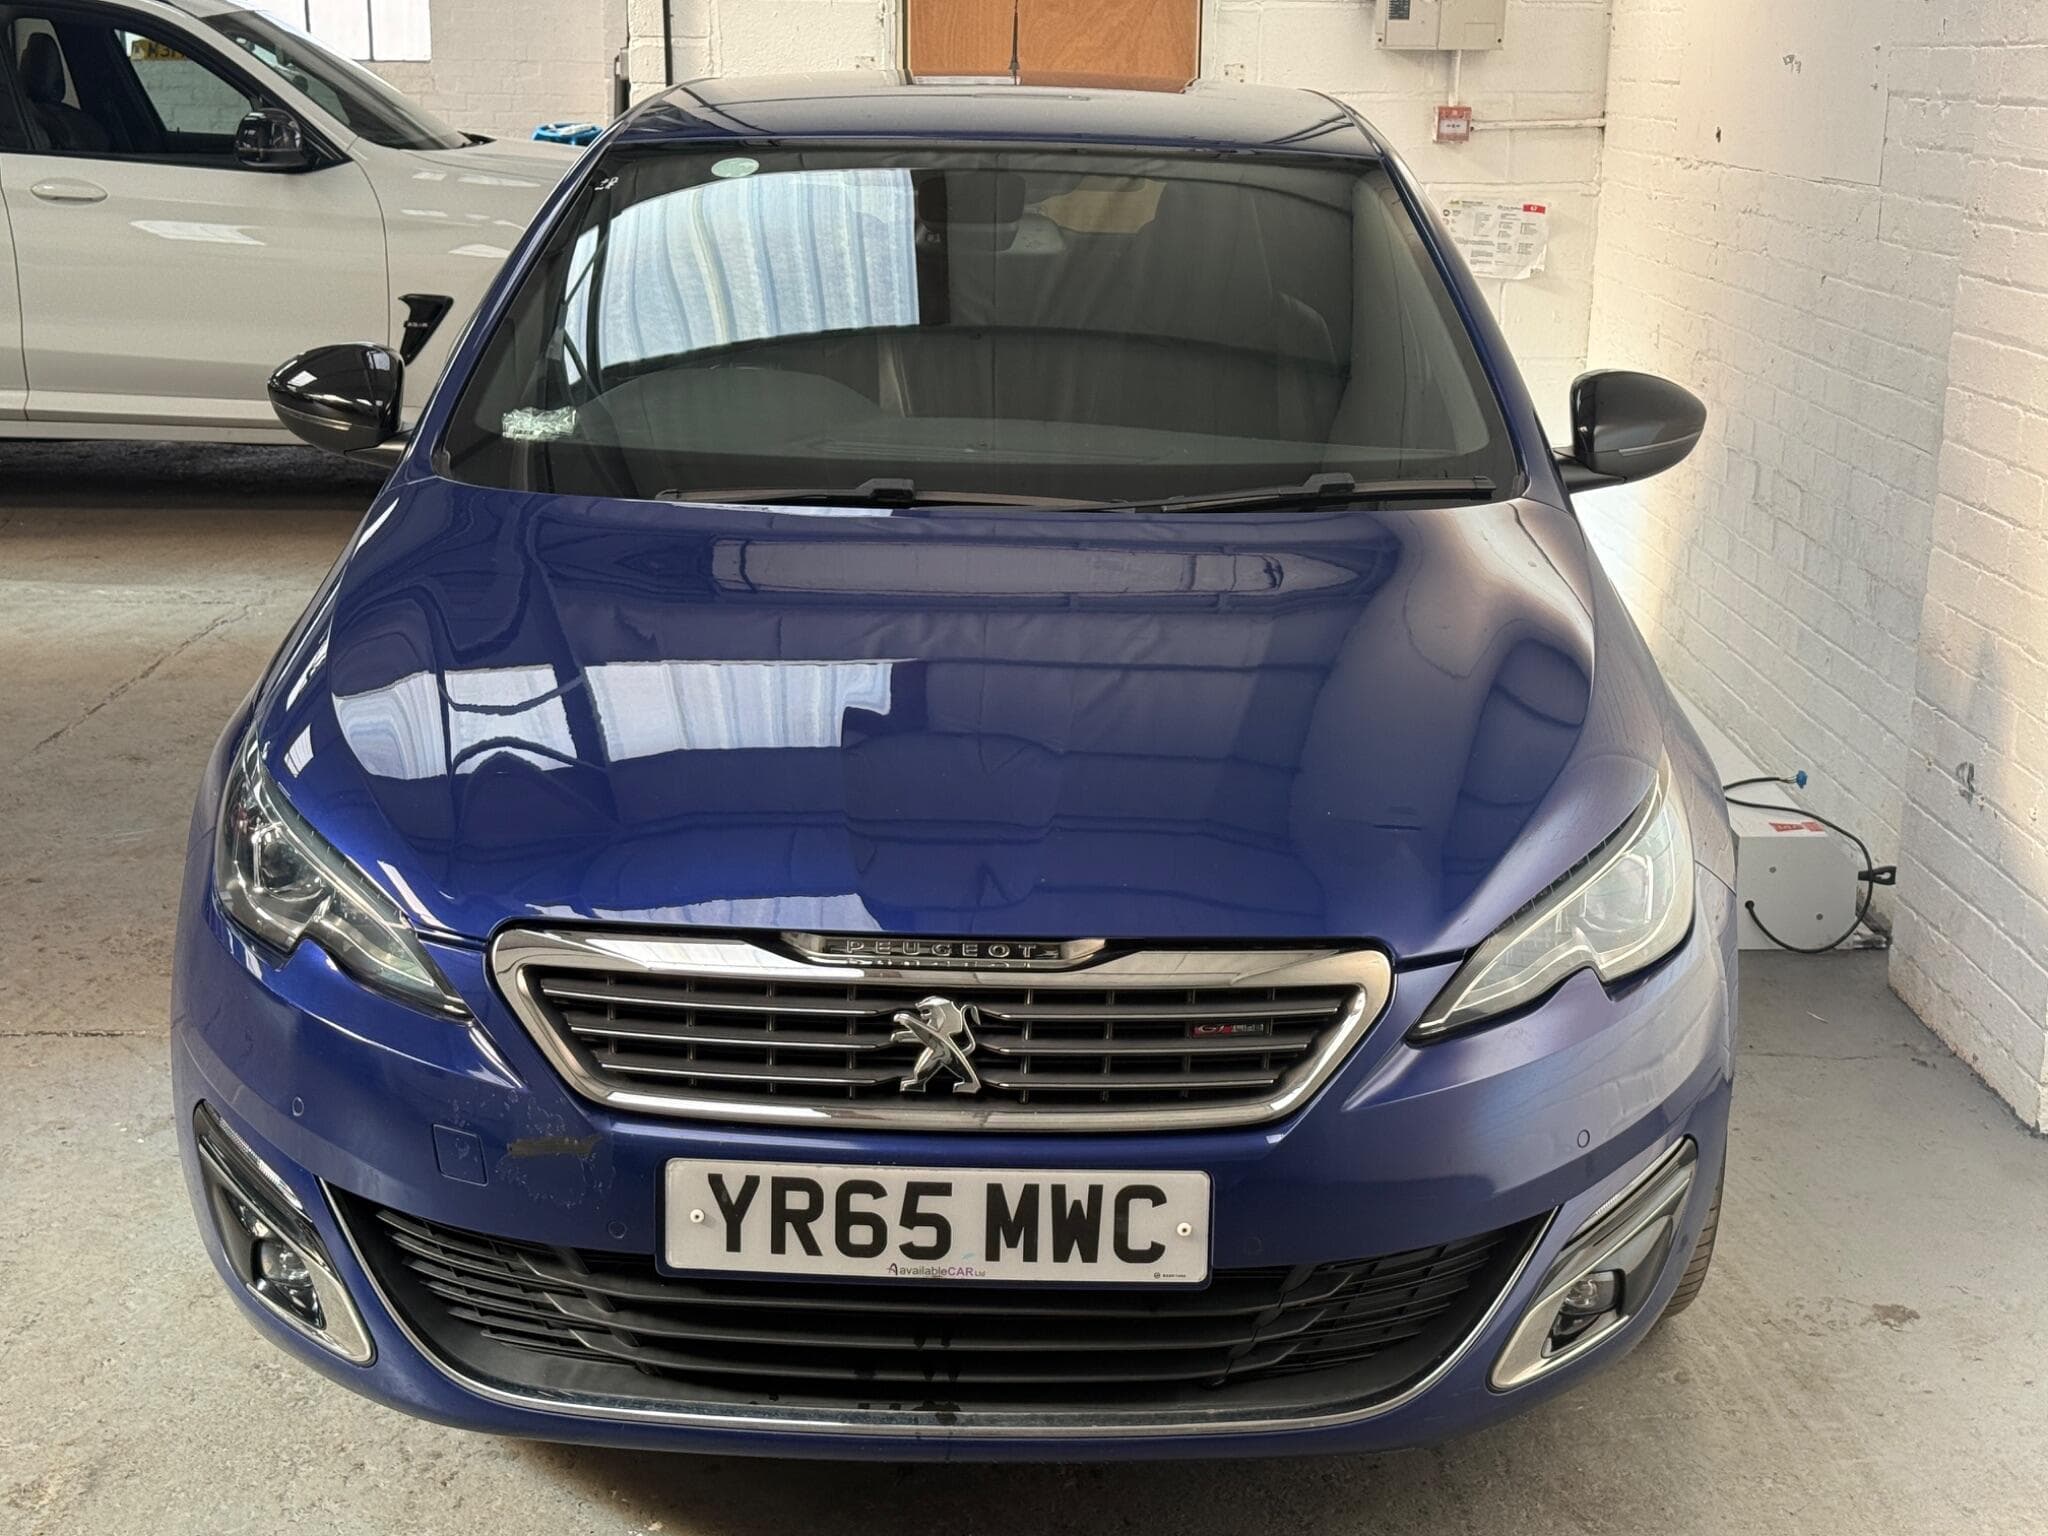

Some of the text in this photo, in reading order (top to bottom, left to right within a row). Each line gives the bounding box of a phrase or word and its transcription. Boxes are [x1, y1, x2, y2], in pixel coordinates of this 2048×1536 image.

[846, 939, 1037, 958] PEUGEOT
[707, 1172, 1168, 1264] YR65 MWC
